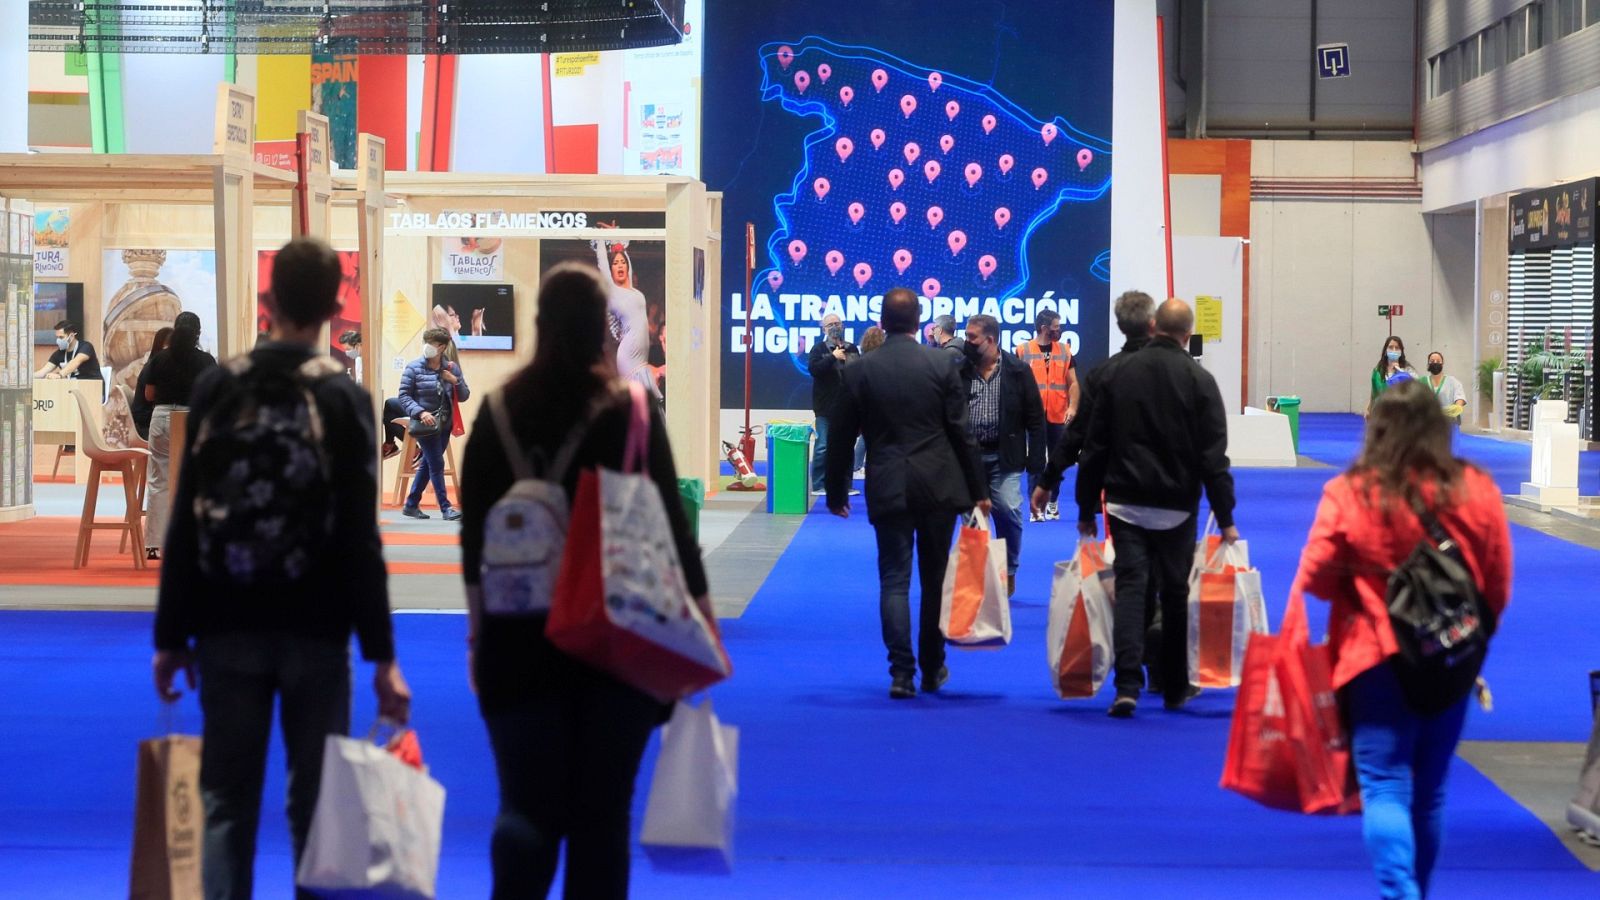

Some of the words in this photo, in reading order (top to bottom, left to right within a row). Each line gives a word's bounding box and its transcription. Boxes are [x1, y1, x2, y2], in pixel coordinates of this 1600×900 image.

[311, 61, 359, 84] SPAIN
[391, 212, 473, 228] TABLAOS
[475, 212, 587, 228] FLAMENCOS
[35, 250, 60, 263] TURA
[450, 254, 497, 266] TABLAOS
[454, 265, 494, 276] FLAMENCOS
[731, 293, 775, 320] LA
[779, 290, 1079, 325] TRANSORMACIÓN
[731, 326, 862, 354] DIGITL
